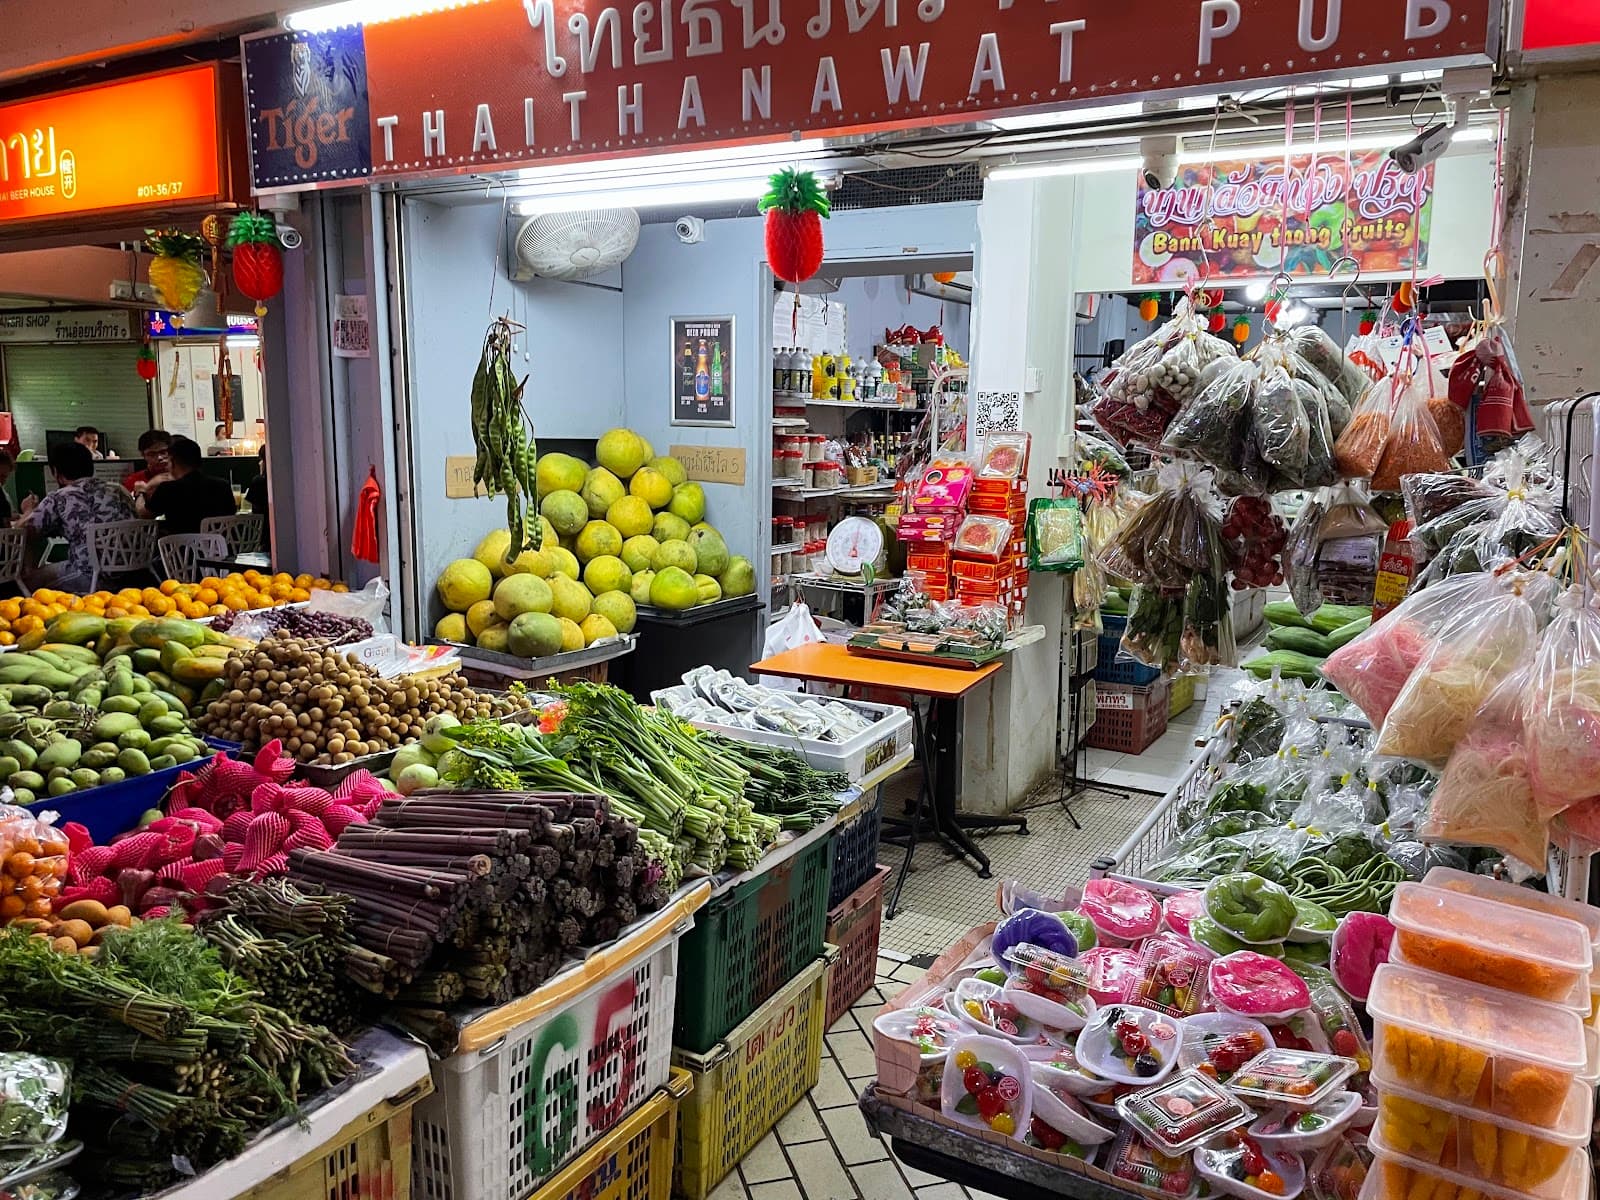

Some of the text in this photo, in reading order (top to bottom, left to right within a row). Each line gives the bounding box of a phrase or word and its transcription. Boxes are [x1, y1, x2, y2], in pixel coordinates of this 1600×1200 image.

[377, 0, 1451, 161] THAITHANAWAT PUB
[259, 97, 354, 169] Tiger
[10, 188, 29, 200] BEER
[30, 185, 55, 198] HOUSE
[137, 182, 183, 198] #01-36/37
[1211, 227, 1264, 253] Kuay
[1340, 218, 1406, 242] fruits
[26, 314, 50, 328] SHOP
